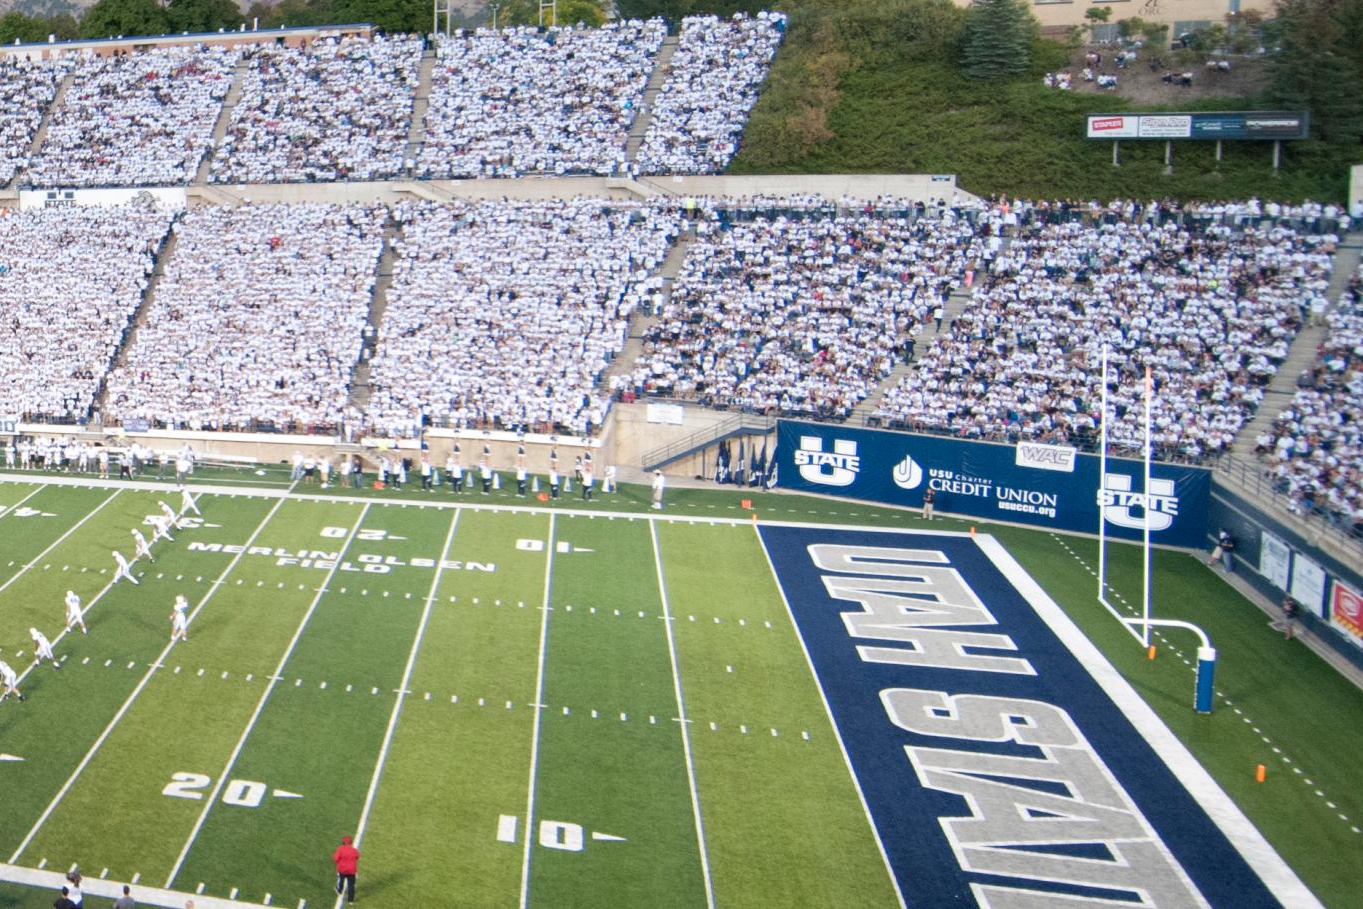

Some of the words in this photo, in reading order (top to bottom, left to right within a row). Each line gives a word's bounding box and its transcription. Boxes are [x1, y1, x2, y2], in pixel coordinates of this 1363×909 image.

[794, 449, 860, 472] STATE
[1021, 445, 1073, 466] WAC
[929, 468, 953, 479] USU
[929, 478, 992, 497] CREDIT
[996, 486, 1058, 507] UNION
[1096, 489, 1179, 516] STATE
[998, 501, 1056, 518] usuccu.org
[187, 542, 340, 560] MERLIN
[357, 554, 497, 572] OLSEN
[275, 557, 391, 574] FIELD
[806, 543, 1039, 676] UTAH
[162, 772, 268, 808] 20
[497, 814, 585, 852] 10
